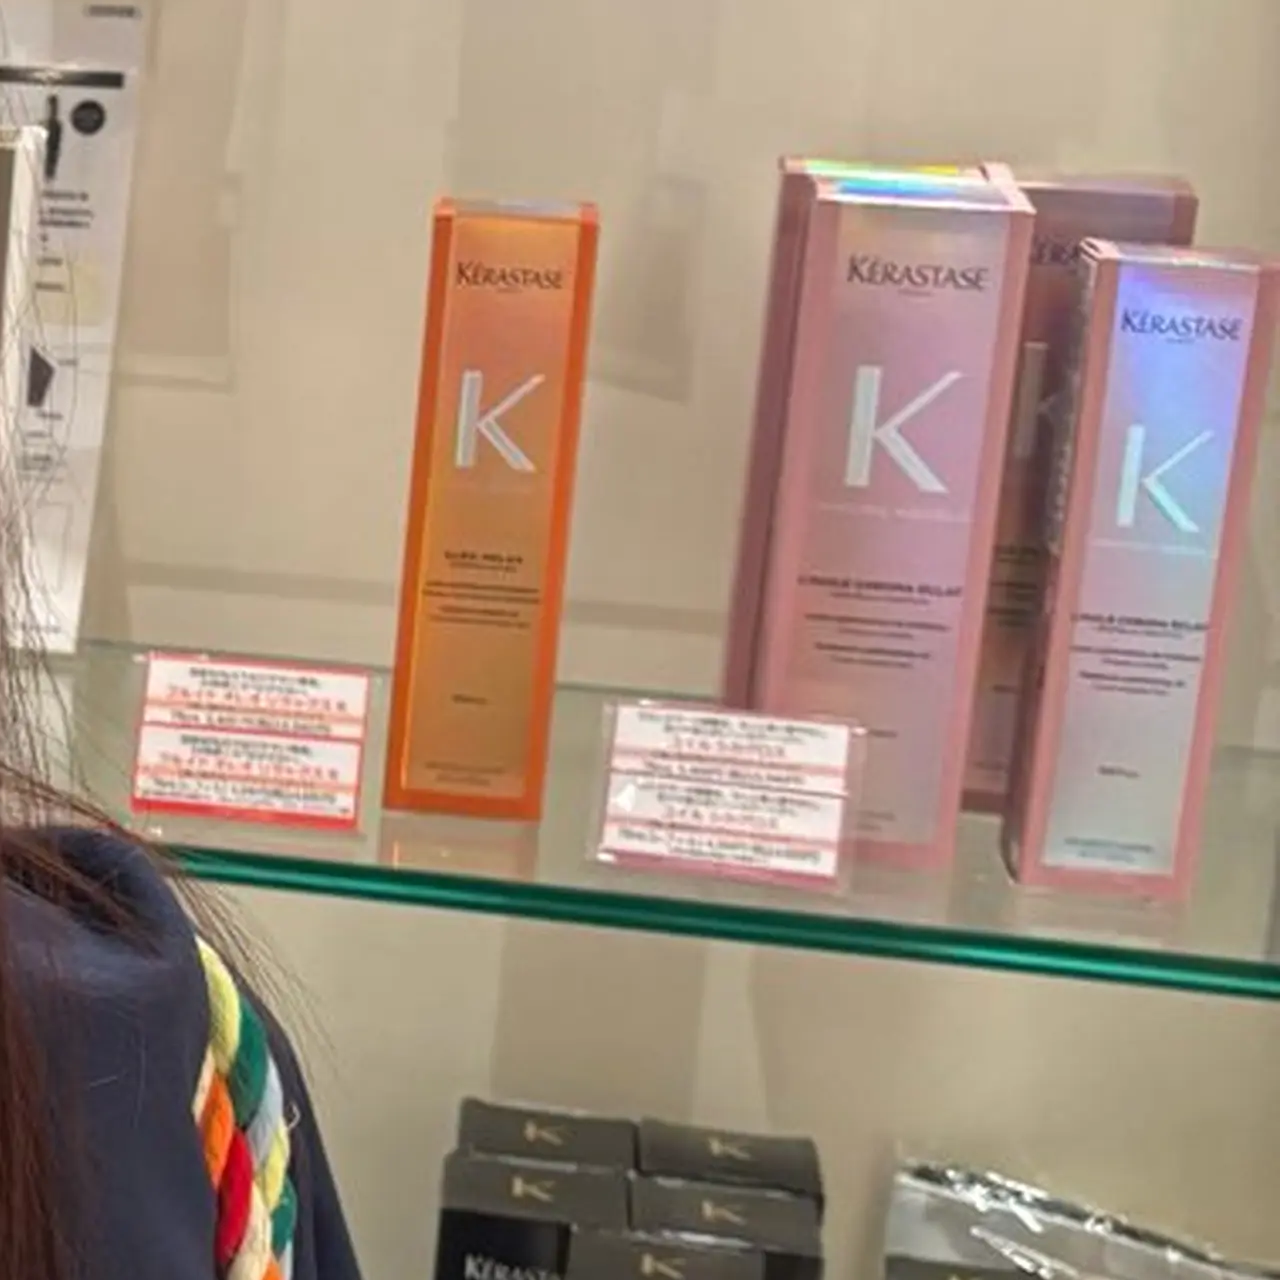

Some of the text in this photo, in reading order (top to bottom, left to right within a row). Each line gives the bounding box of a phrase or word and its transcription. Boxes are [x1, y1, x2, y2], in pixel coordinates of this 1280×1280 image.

[456, 260, 563, 291] KÉRASTASE
[846, 254, 988, 293] KÉRASTASE
[1122, 306, 1243, 341] KÉRASTASE
[455, 369, 546, 472] K
[844, 364, 965, 494] K
[1116, 424, 1215, 534] K
